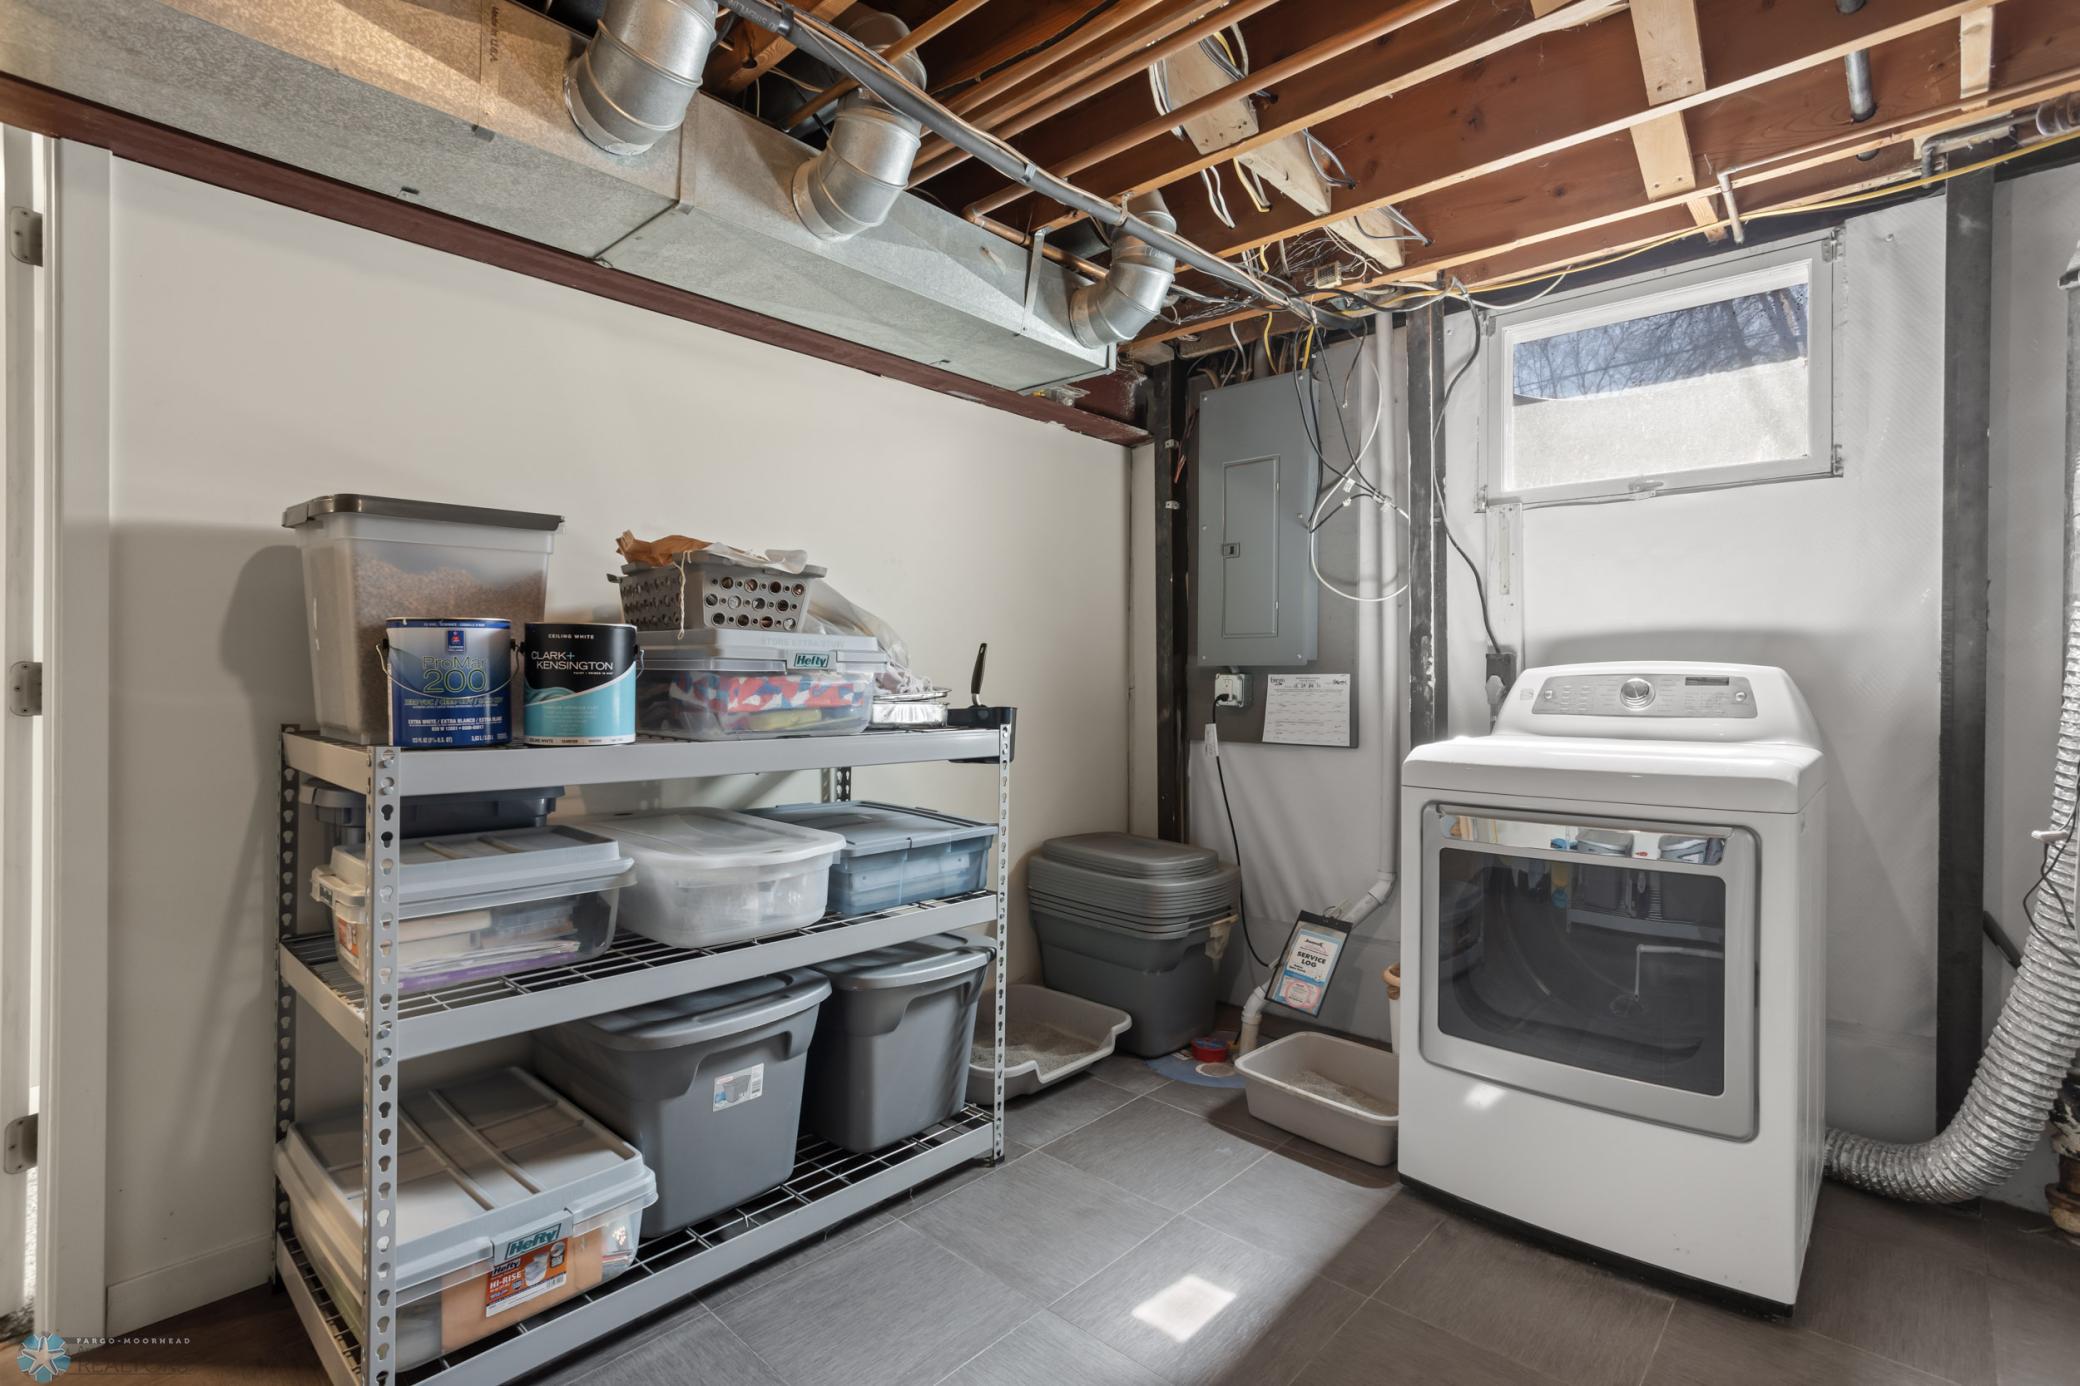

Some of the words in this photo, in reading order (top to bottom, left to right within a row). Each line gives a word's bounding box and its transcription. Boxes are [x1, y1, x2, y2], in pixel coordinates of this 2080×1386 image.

[422, 655, 487, 669] ProMar
[531, 651, 575, 660] CLARK+
[796, 655, 827, 667] Hefty
[536, 661, 614, 671] KENSINGTON
[423, 669, 488, 693] 200
[1297, 951, 1326, 965] SERVICE
[1301, 958, 1317, 968] LOG
[509, 1230, 556, 1256] Hefty
[493, 1261, 520, 1275] Hefty
[489, 1271, 522, 1290] HI-RISE
